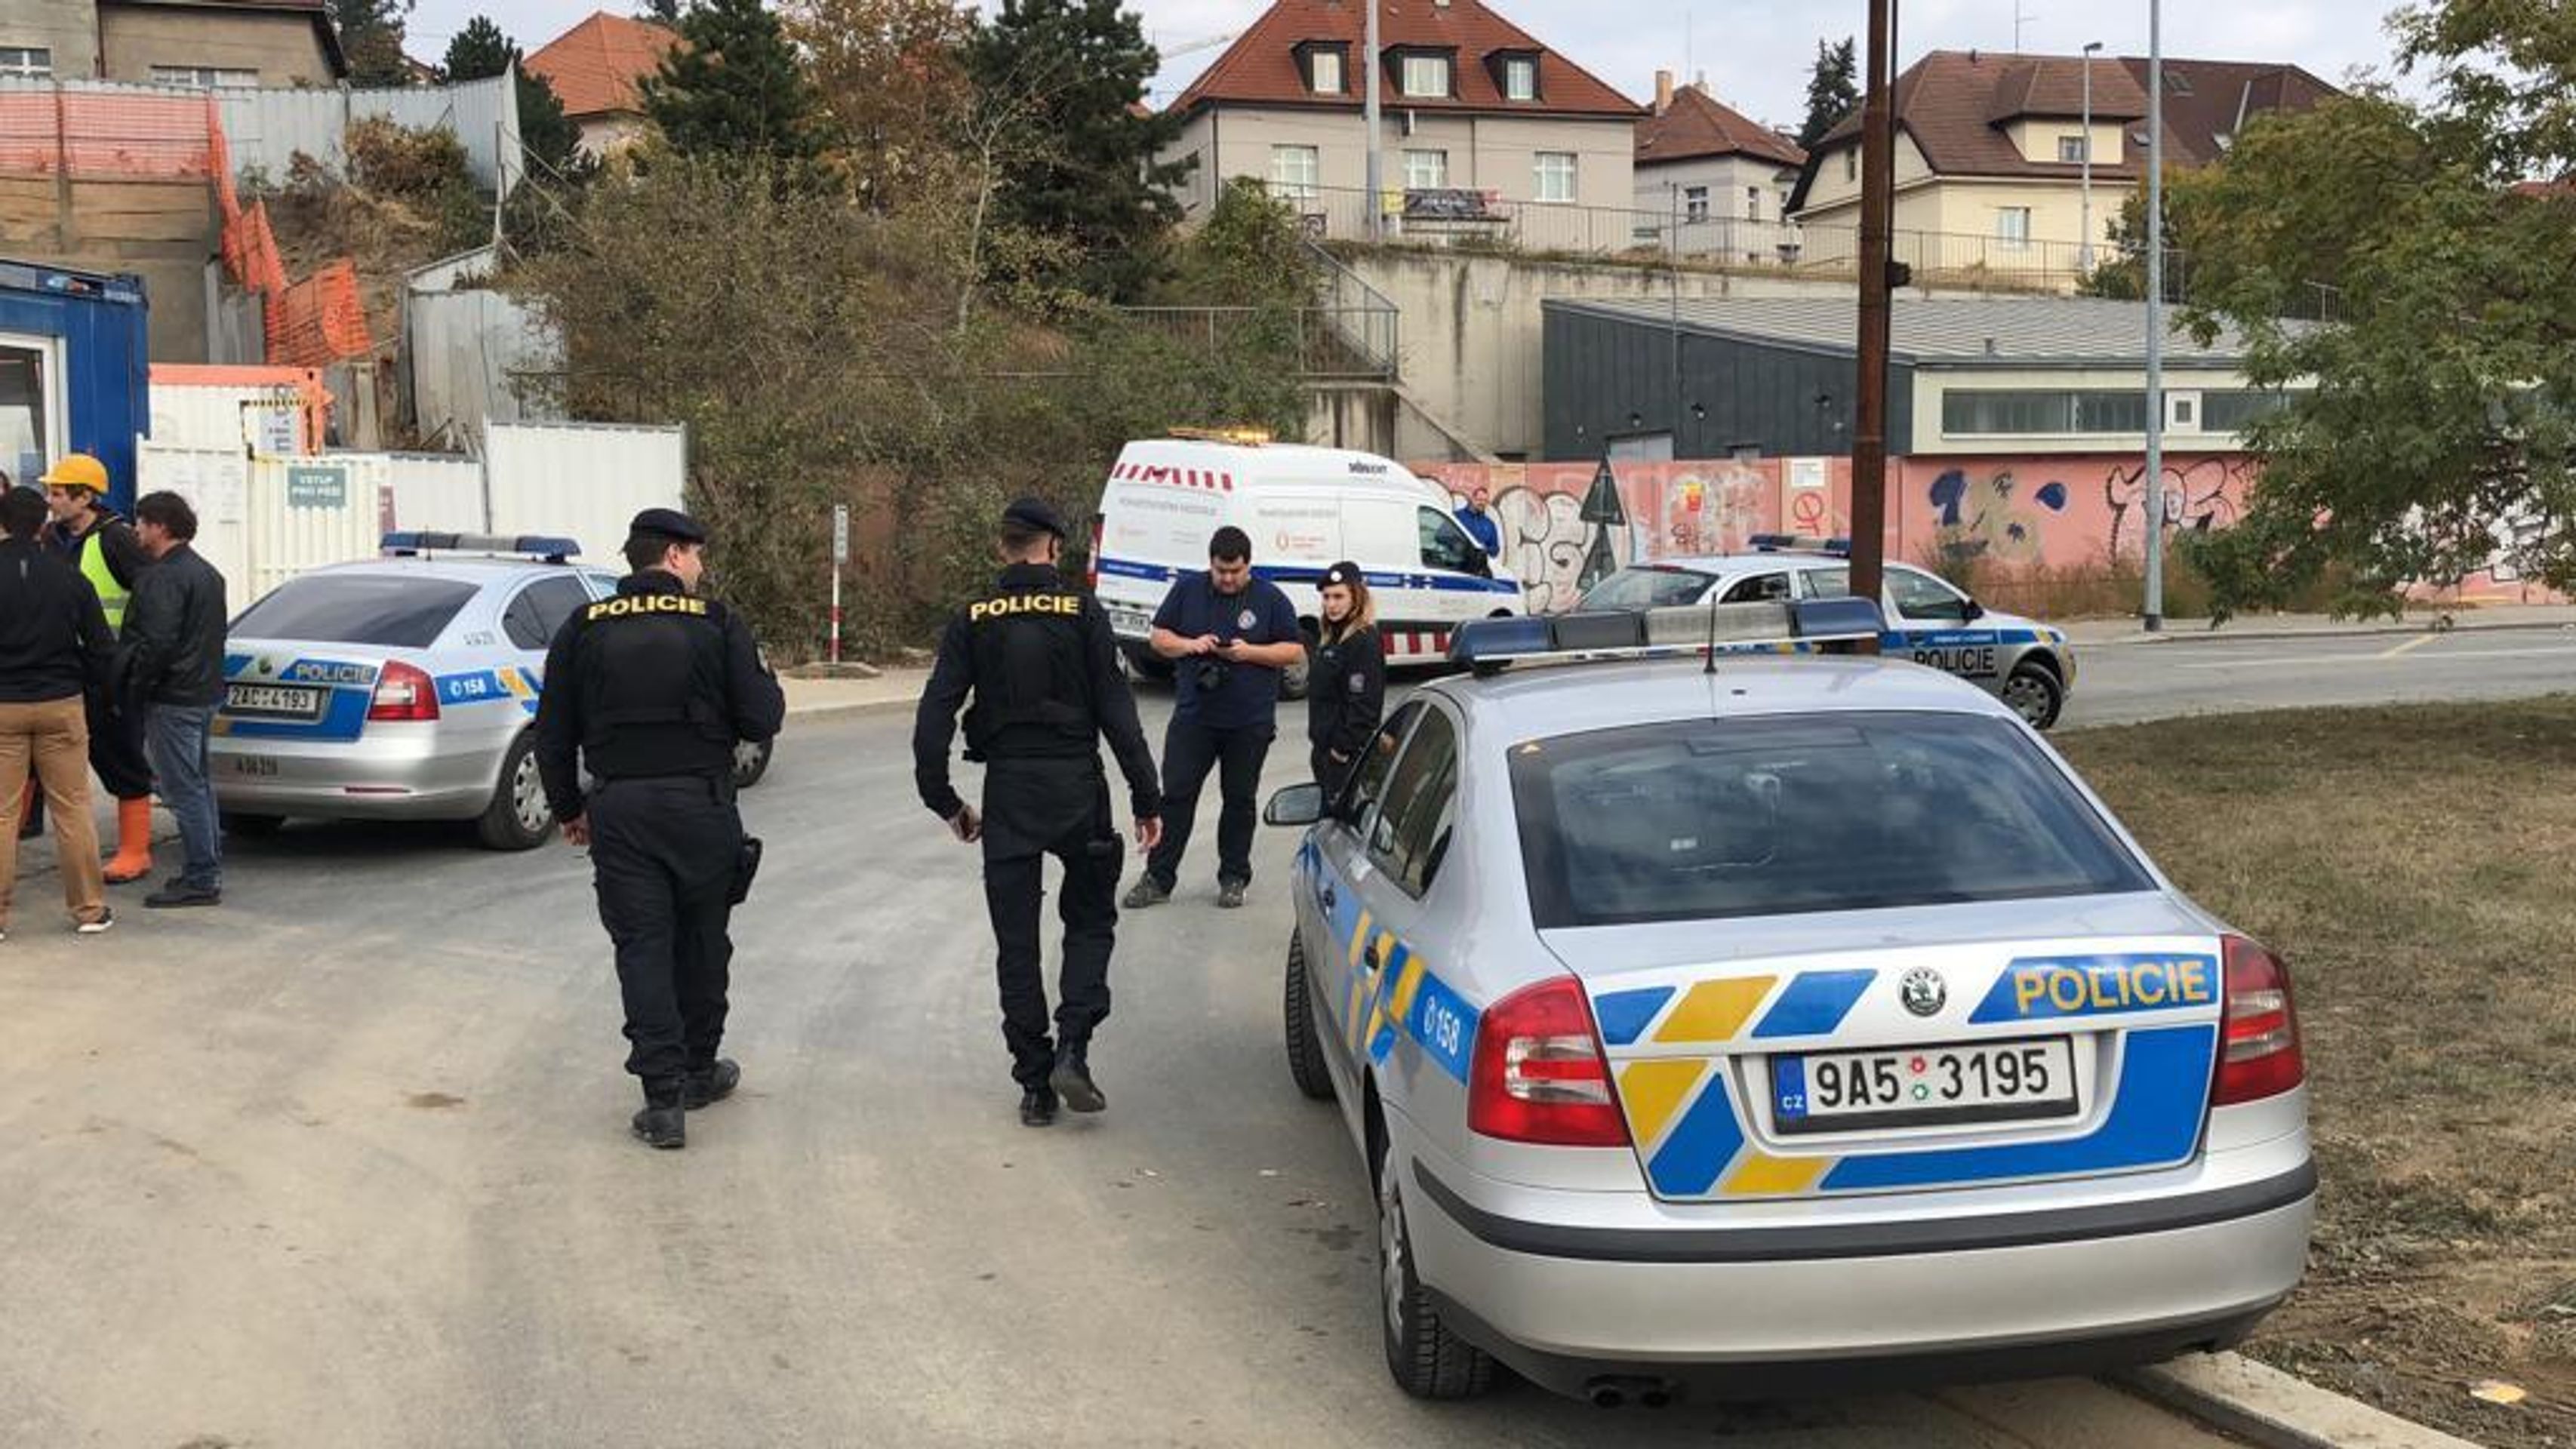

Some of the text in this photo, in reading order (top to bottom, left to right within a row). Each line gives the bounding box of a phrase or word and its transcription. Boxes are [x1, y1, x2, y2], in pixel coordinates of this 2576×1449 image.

[588, 595, 706, 620] POLICIE
[971, 595, 1080, 621] POLICIE
[1914, 648, 1994, 670] POLICIE
[297, 664, 372, 682] POLICIE
[463, 678, 487, 694] 158
[2014, 960, 2209, 1014] POLICIE
[1436, 1006, 1460, 1057] 158
[1816, 1048, 2049, 1108] 9A5 3195
[1782, 1094, 1804, 1109] CZ
